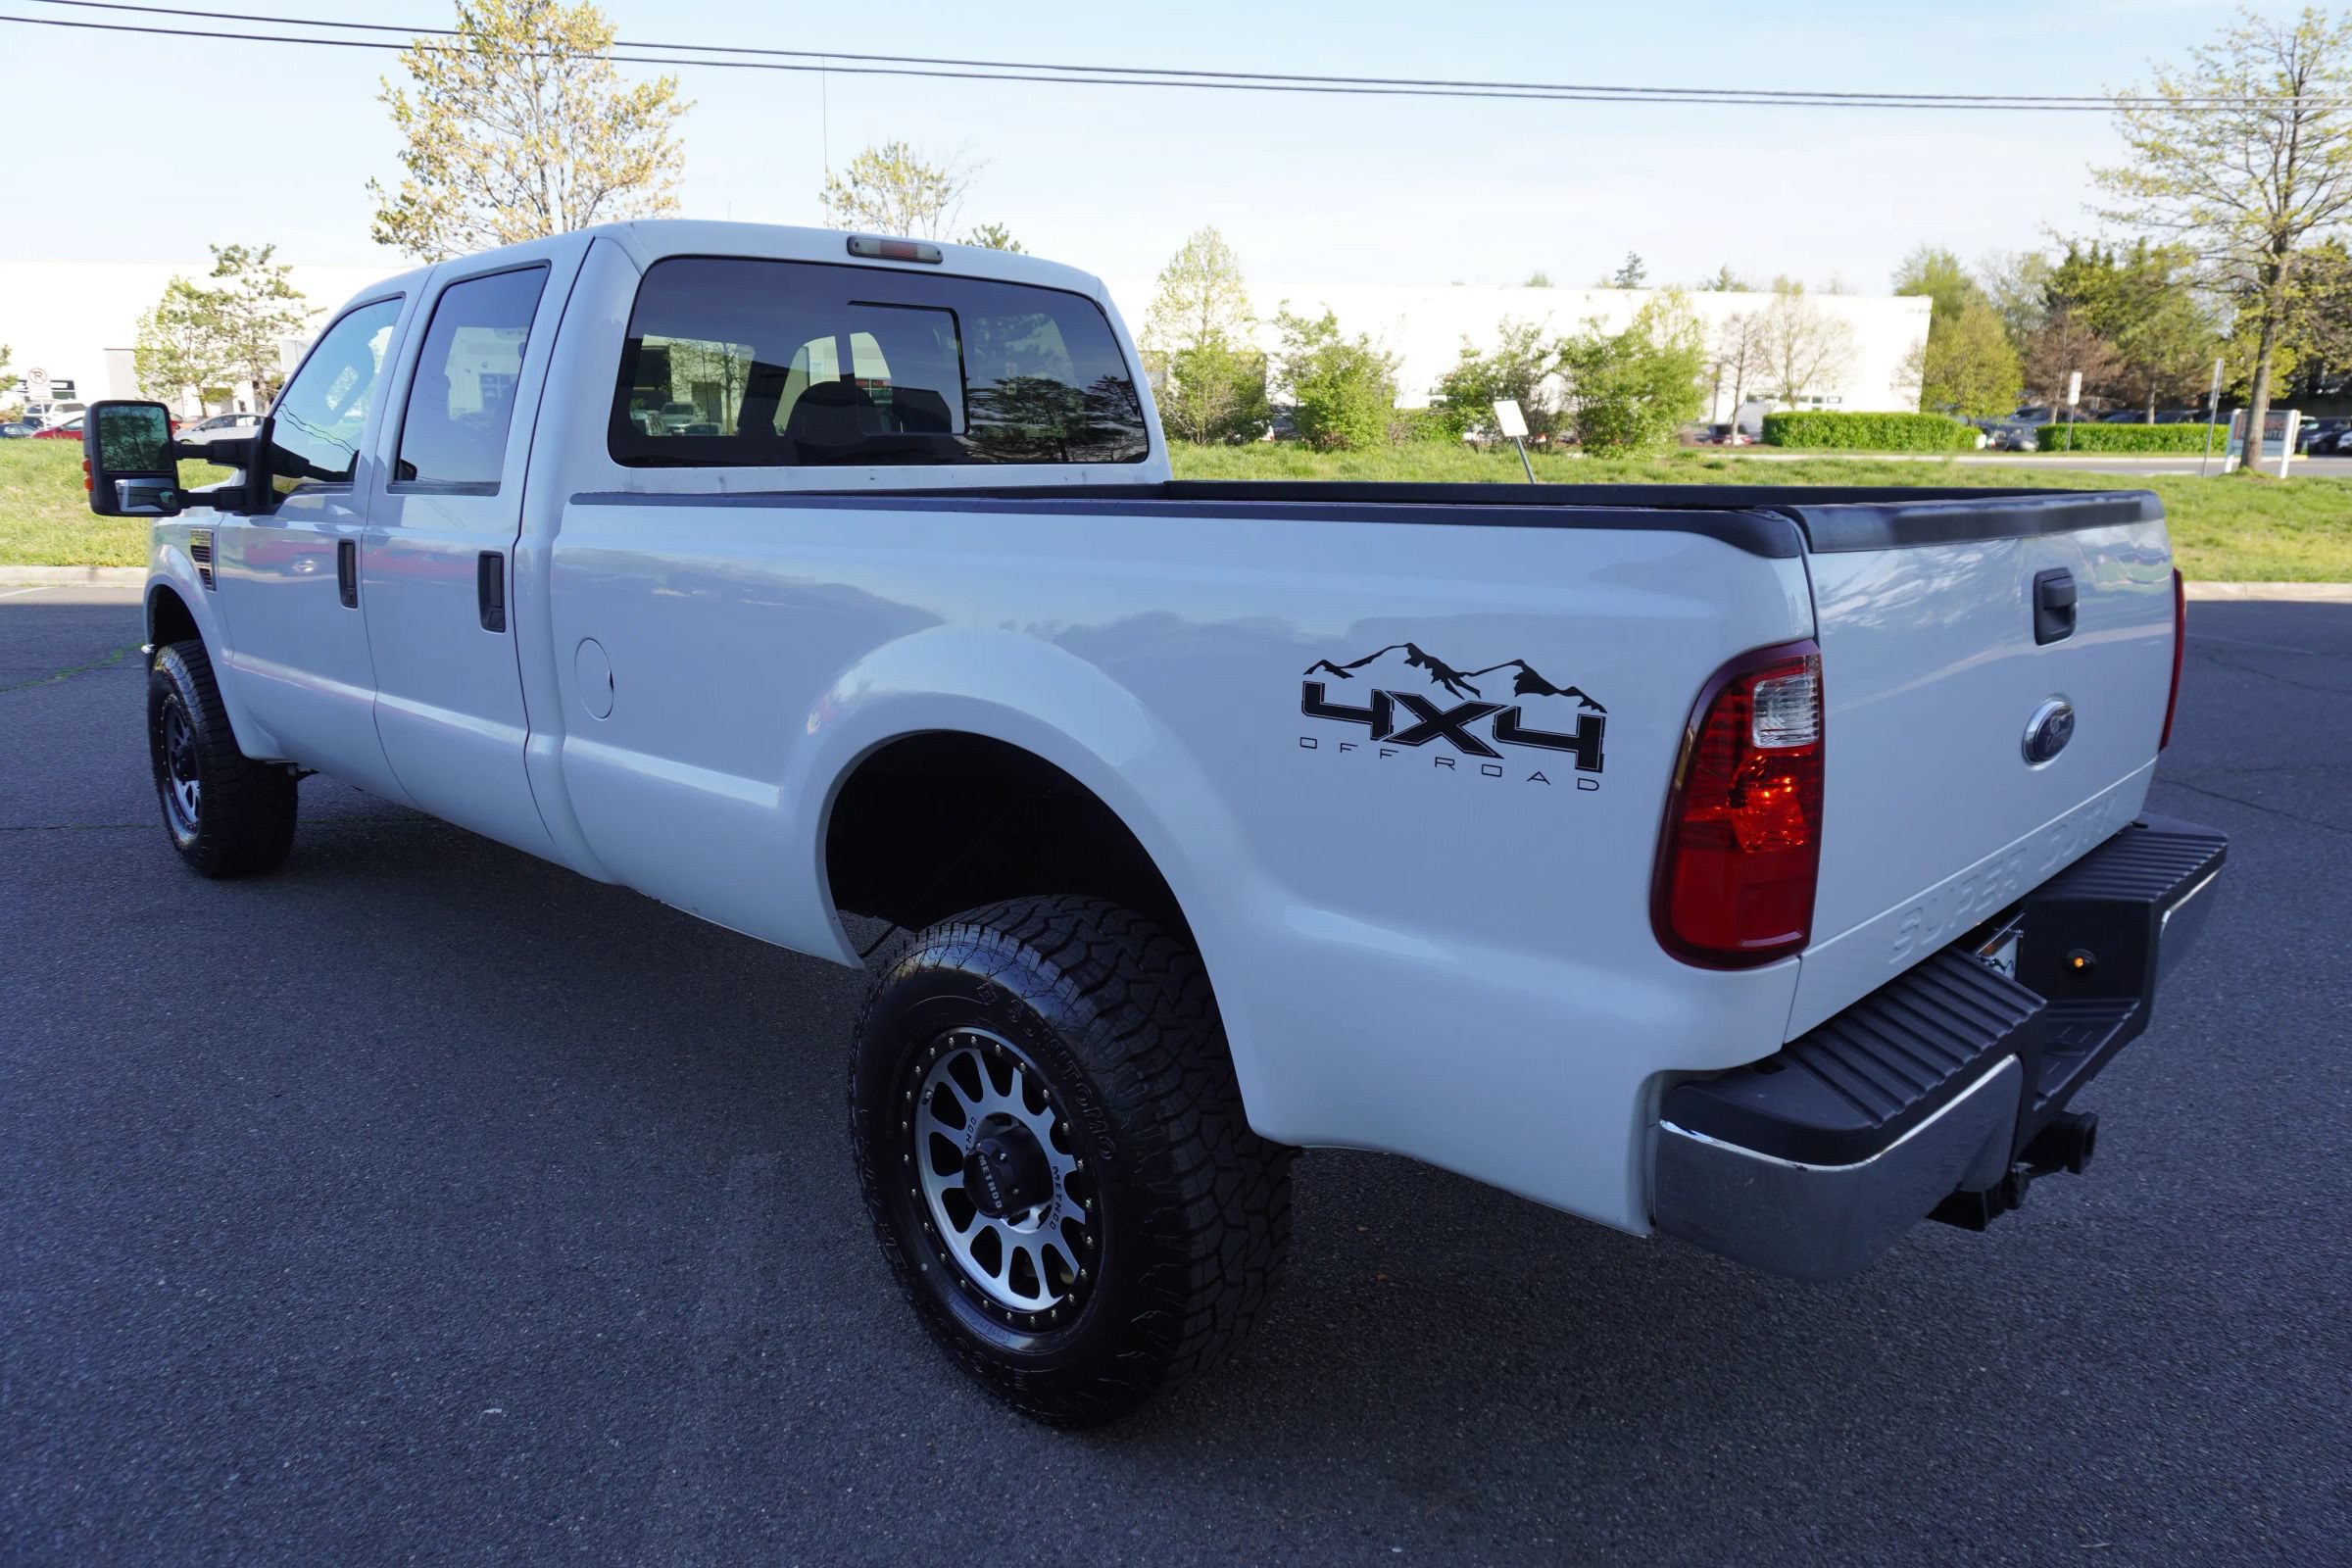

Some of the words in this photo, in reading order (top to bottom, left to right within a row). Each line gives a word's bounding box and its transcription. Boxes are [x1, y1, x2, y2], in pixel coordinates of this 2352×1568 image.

[1888, 847, 2028, 965] SUPER
[979, 1154, 1004, 1209] METHOD
[1049, 1165, 1062, 1230] METHOD
